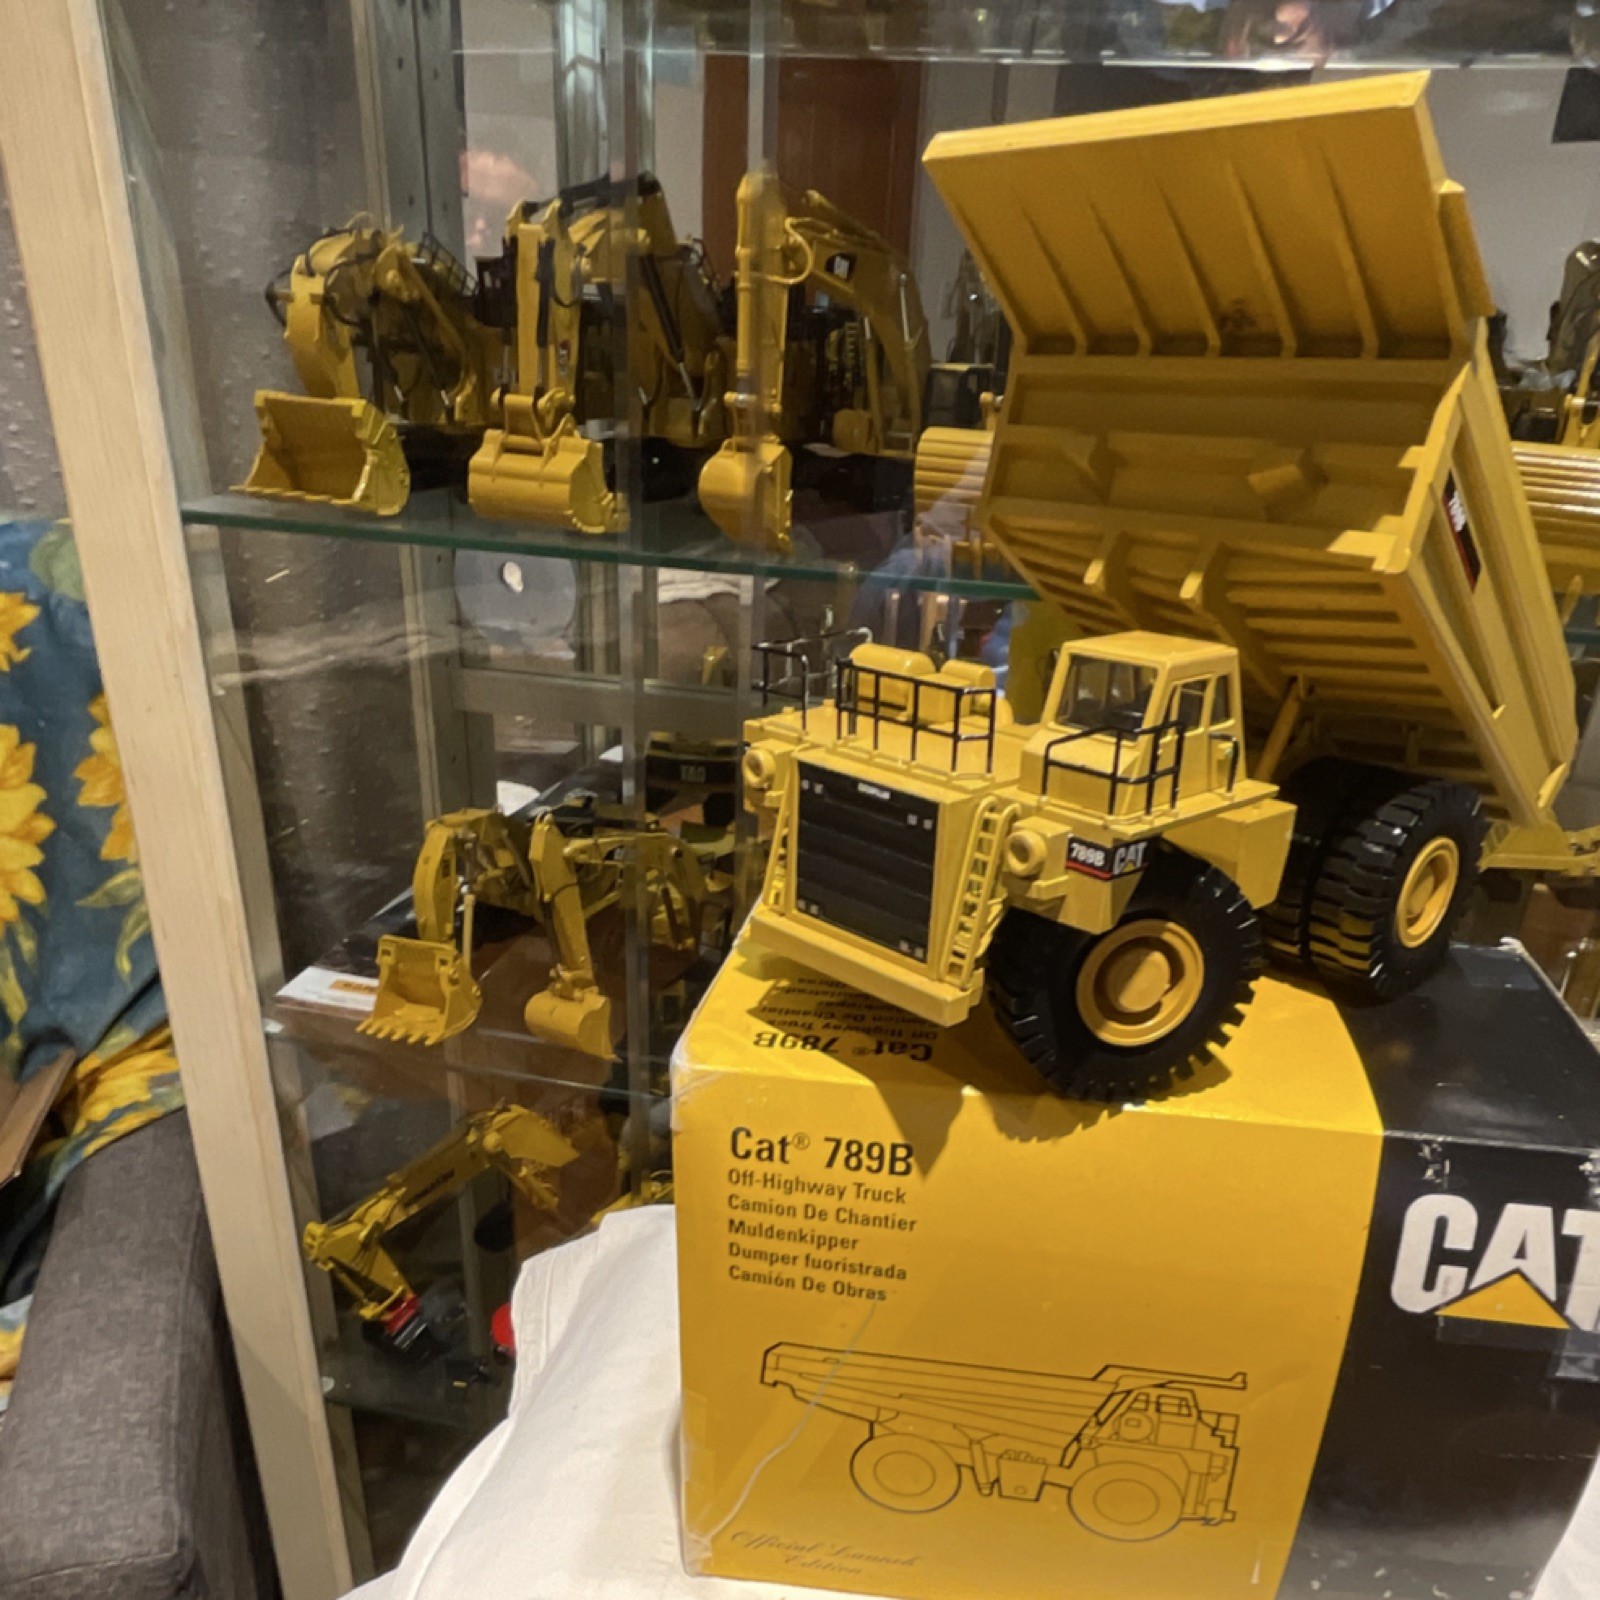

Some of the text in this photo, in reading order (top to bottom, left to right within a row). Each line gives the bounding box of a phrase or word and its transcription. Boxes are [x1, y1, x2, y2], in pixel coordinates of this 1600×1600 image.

[1113, 841, 1148, 875] CAT
[753, 1032, 840, 1053] 789B
[823, 1137, 914, 1176] 789B
[728, 1168, 906, 1204] Off-Highway Truck
[727, 1193, 917, 1232] Camion De Chantier
[727, 1218, 859, 1251] Muldenkipper
[728, 1242, 907, 1280] Dumper fuoristrada
[1391, 1193, 1600, 1332] CAT
[728, 1264, 887, 1301] Camión De Obras
[731, 1531, 921, 1567] Official Launch
